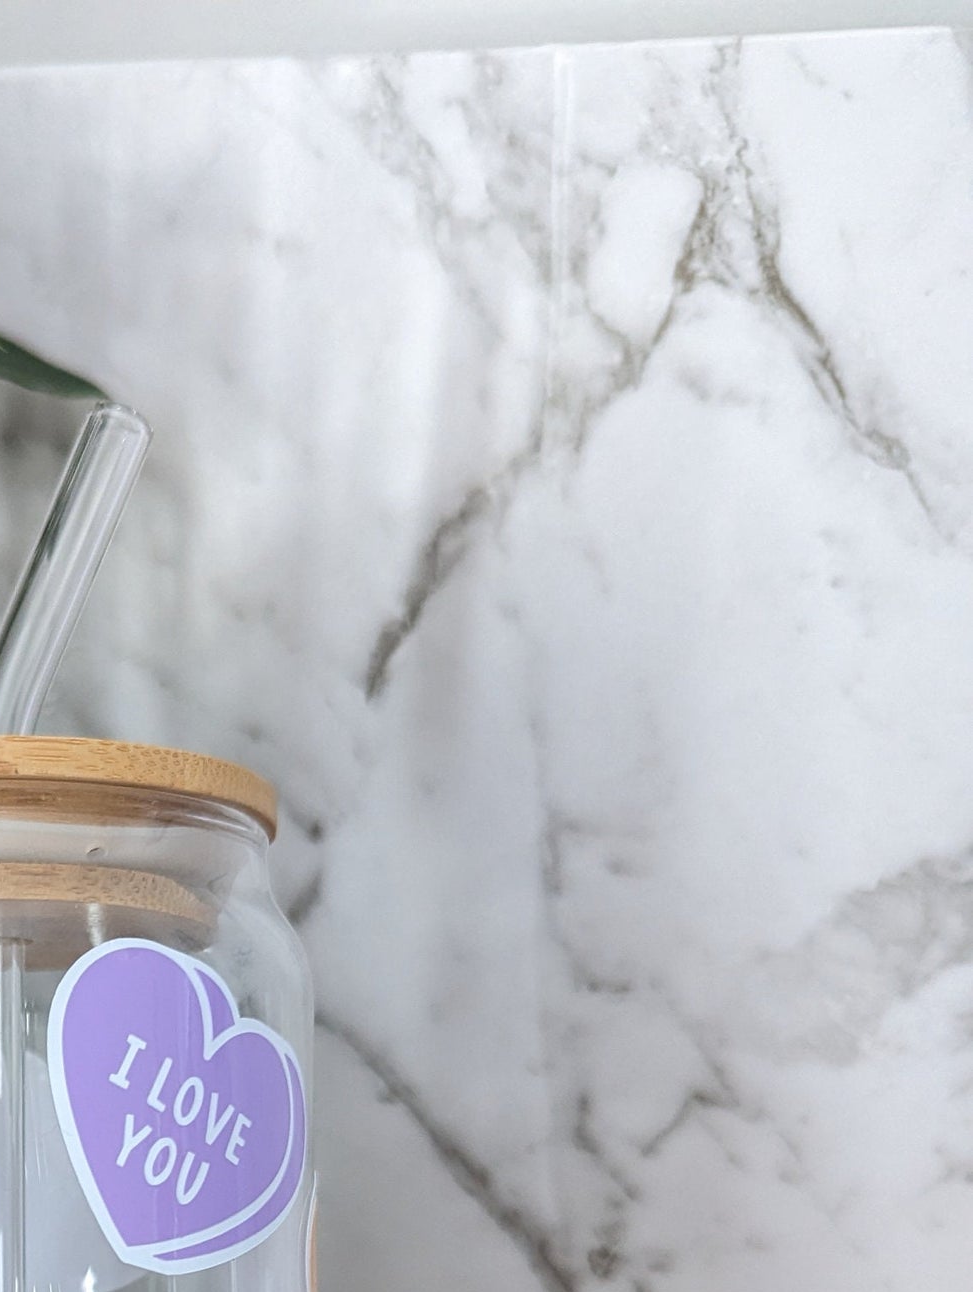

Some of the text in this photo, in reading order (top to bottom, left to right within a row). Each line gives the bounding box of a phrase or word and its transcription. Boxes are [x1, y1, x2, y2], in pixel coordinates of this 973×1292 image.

[108, 1034, 253, 1166] I LOVE
[114, 1114, 211, 1206] YOU
